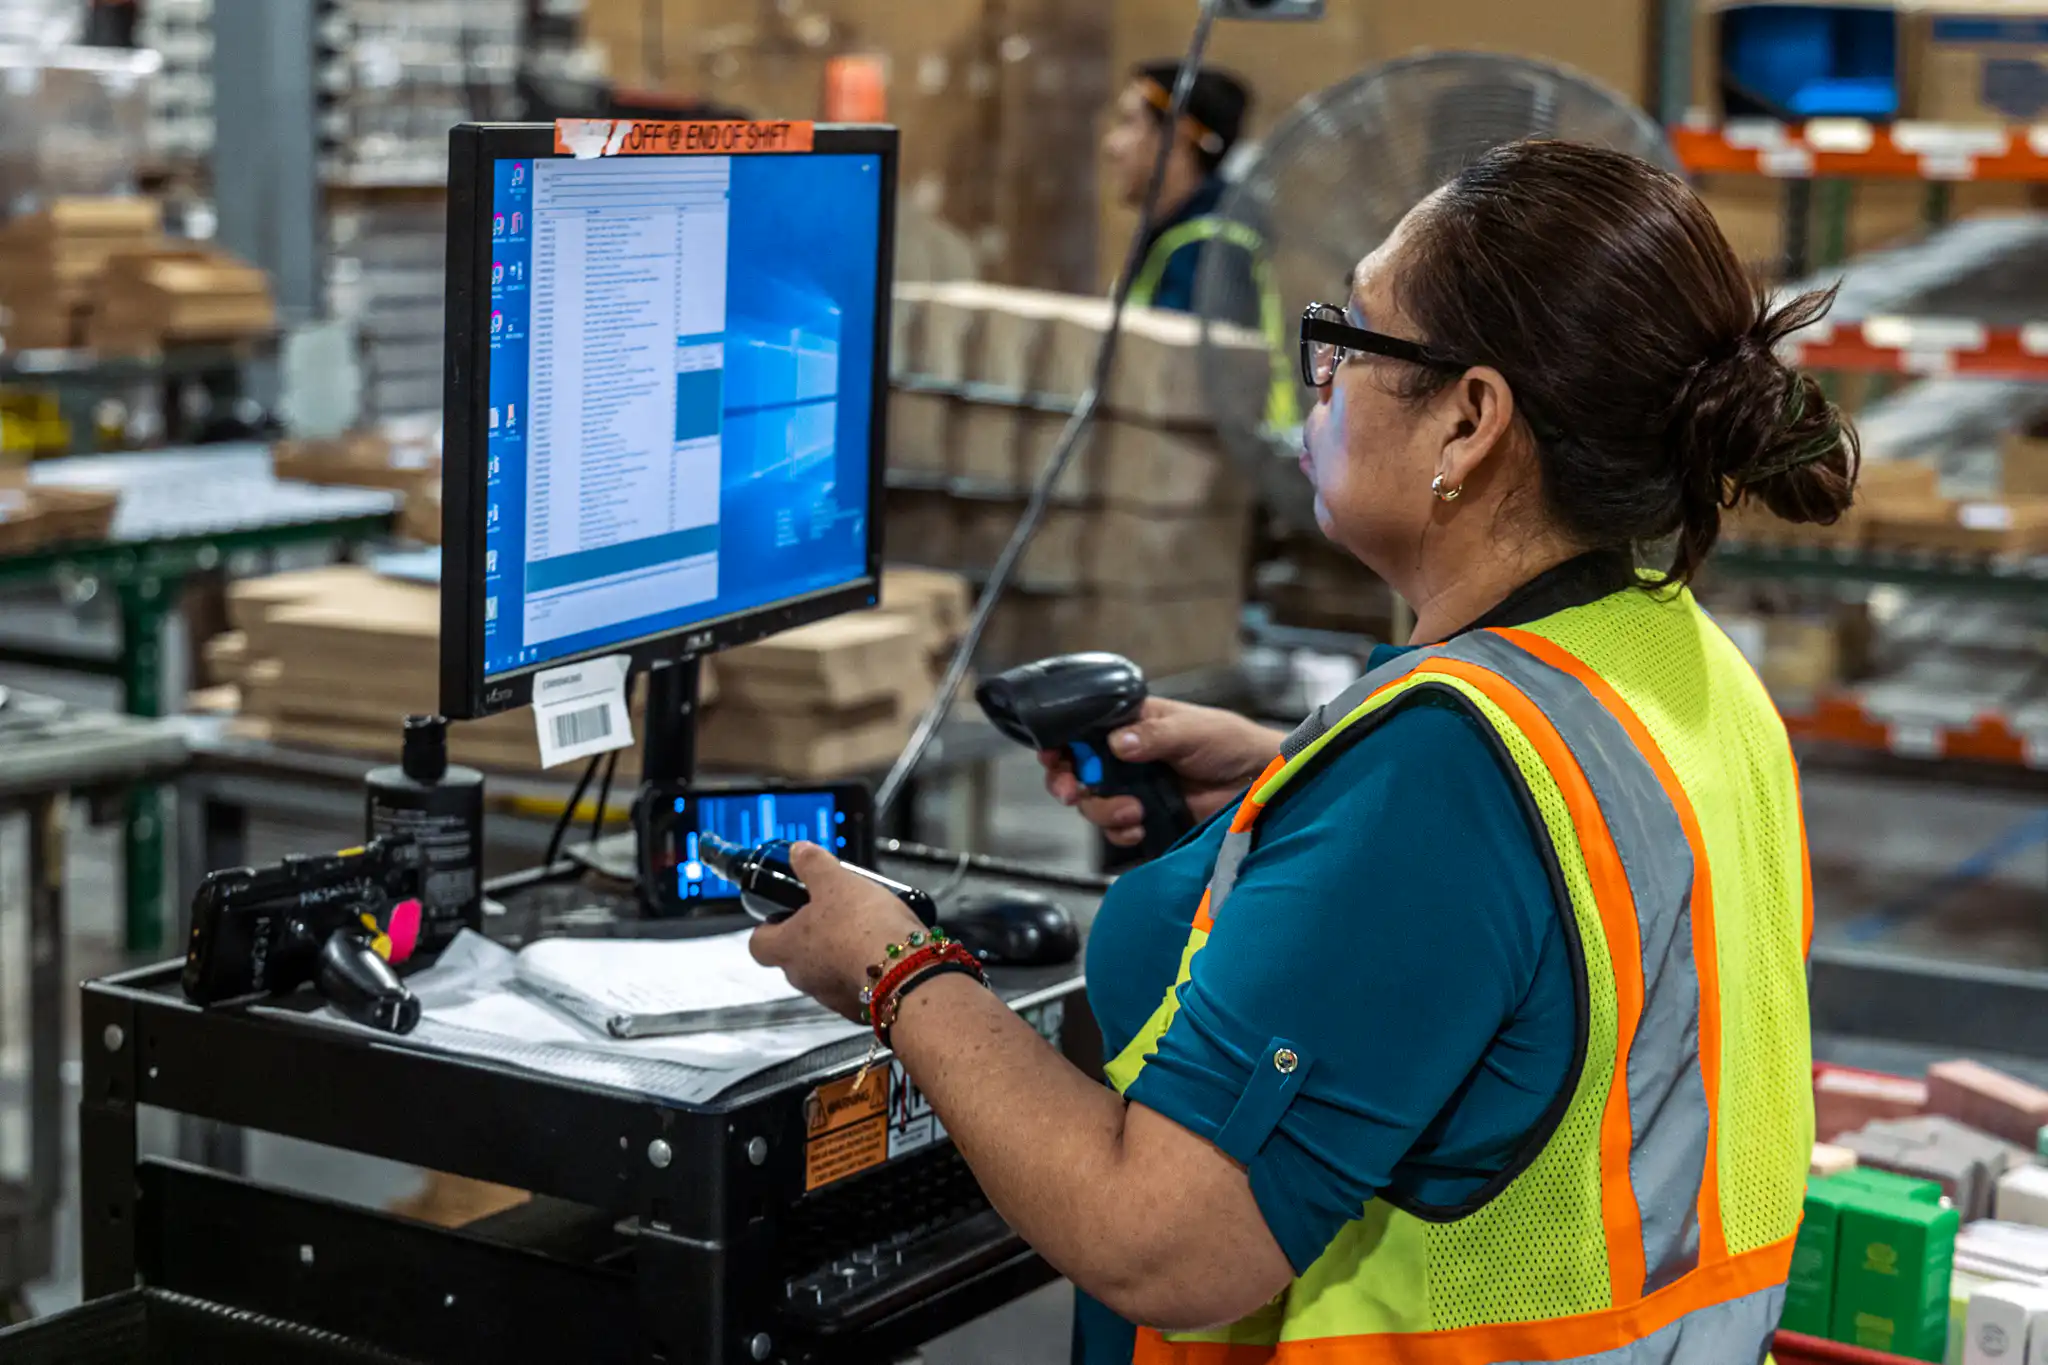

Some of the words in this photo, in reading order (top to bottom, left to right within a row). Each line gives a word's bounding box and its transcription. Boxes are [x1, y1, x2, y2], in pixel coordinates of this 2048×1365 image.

[630, 123, 664, 150] OFF
[668, 125, 681, 149] @
[687, 124, 720, 150] END
[724, 123, 743, 149] OF
[745, 123, 791, 148] SHIFT
[827, 1089, 871, 1115] WARNING
